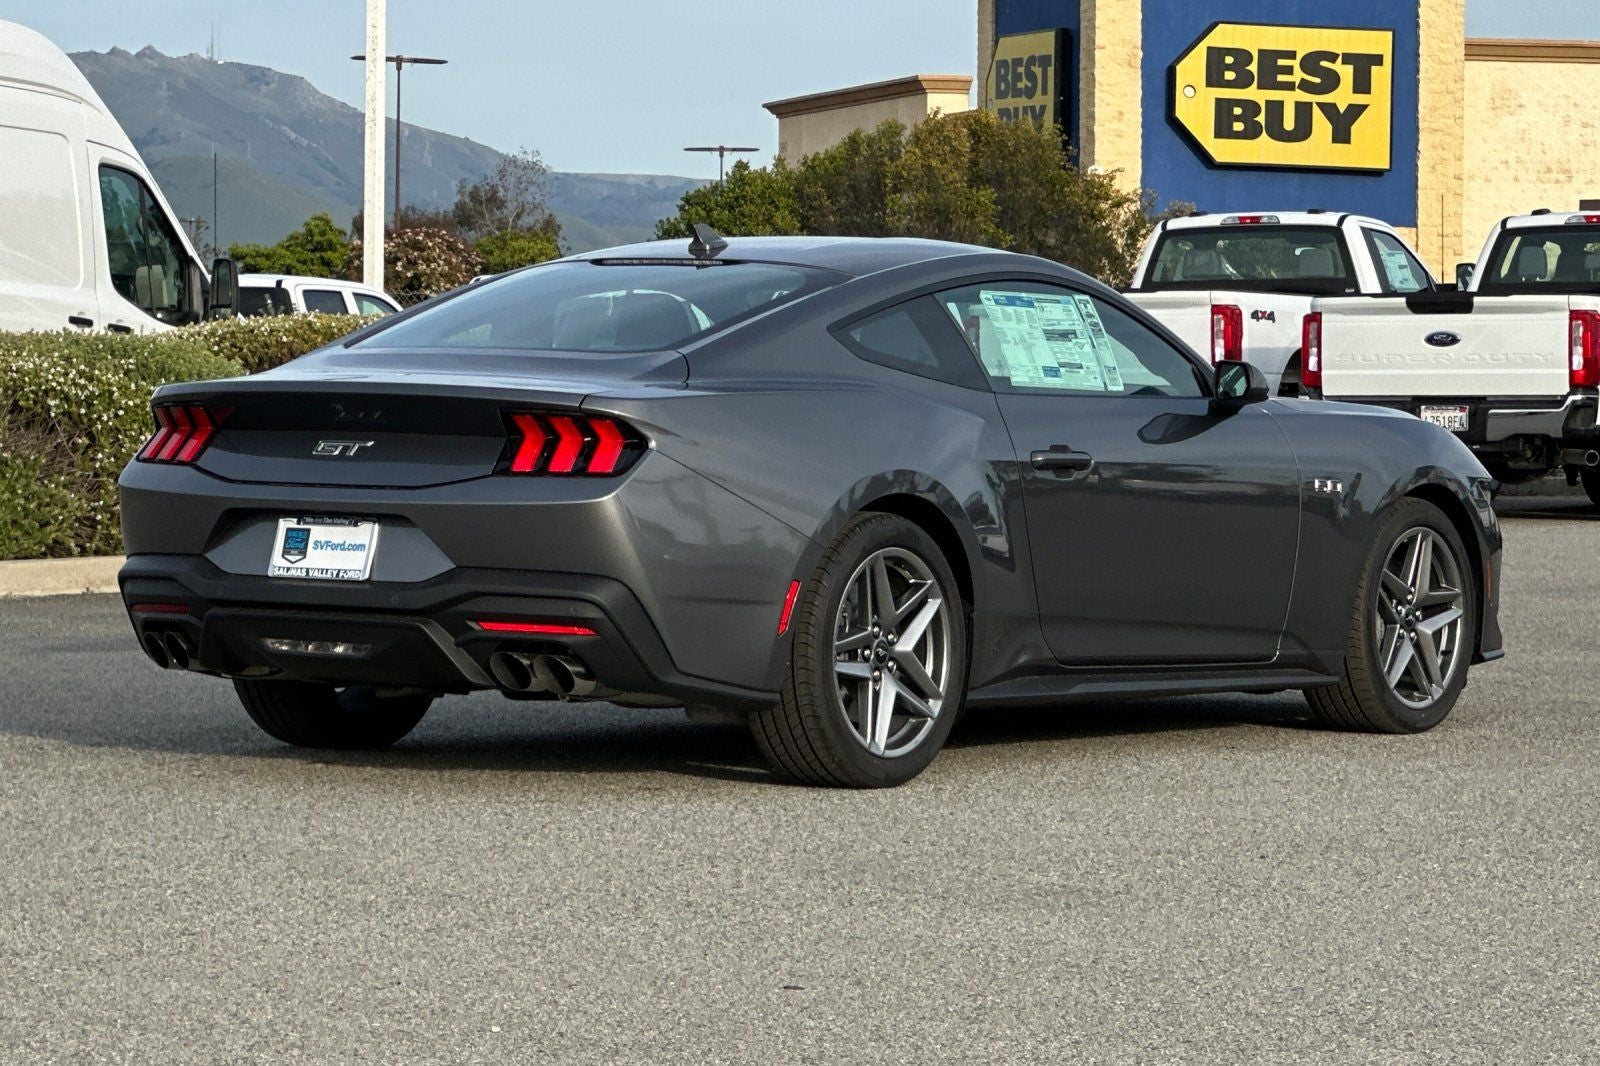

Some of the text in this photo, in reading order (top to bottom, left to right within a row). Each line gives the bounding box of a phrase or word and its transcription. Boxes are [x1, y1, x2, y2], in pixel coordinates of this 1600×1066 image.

[995, 54, 1053, 100] BEST
[1205, 46, 1384, 95] BEST
[1213, 97, 1370, 145] BUY
[1334, 352, 1554, 365] SUPER DUTY
[312, 440, 375, 457] GT
[312, 539, 367, 552] SVFord.com
[273, 566, 307, 577] SALINAS
[308, 568, 338, 578] VALLEY
